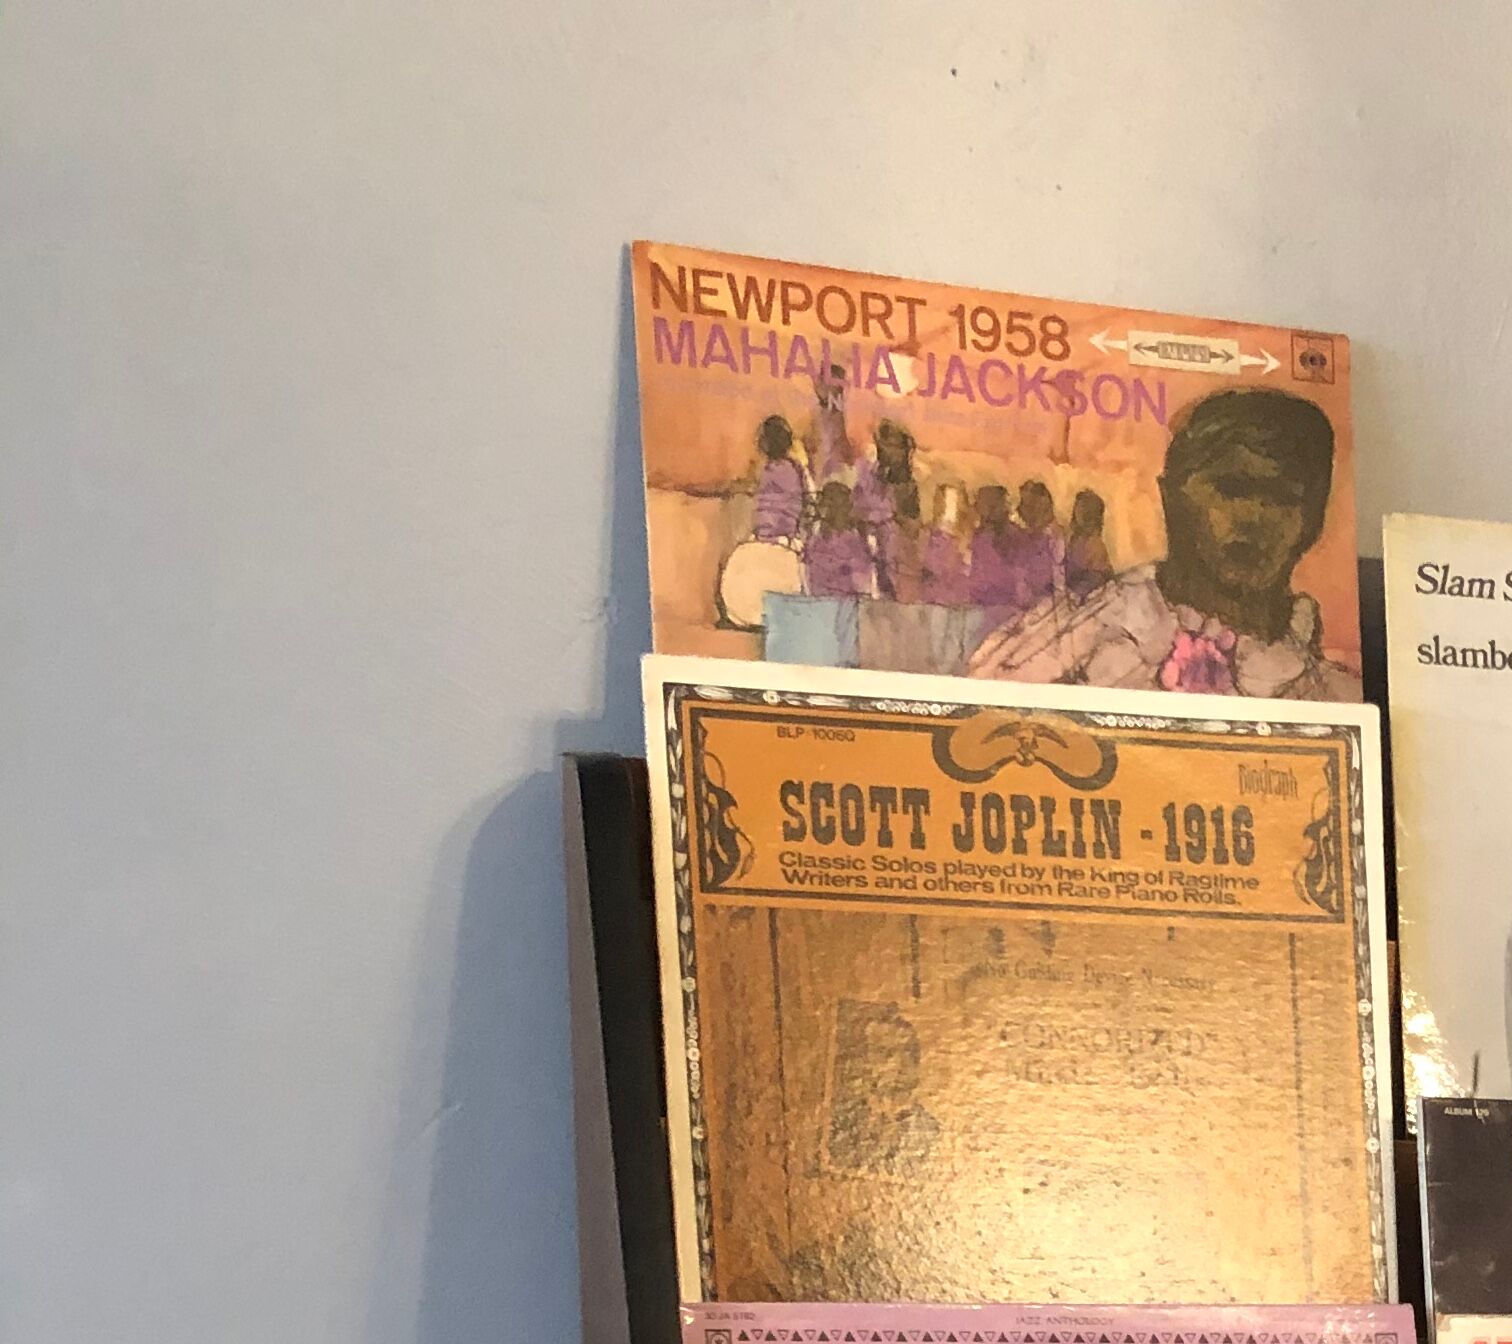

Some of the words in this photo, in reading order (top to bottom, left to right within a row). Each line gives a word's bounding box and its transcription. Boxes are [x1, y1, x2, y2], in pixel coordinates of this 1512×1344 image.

[650, 262, 927, 341] NEWPORT
[948, 303, 1071, 361] 1958
[653, 316, 901, 394] MAHALIA
[917, 352, 1168, 426] JACKSON
[1414, 561, 1496, 600] Slam
[780, 779, 930, 850] SCOTT
[953, 791, 1121, 860] JOPLIN
[779, 851, 866, 871] Classic
[871, 855, 937, 874] Solos
[944, 858, 1018, 882] played
[1021, 863, 1046, 881] by
[1052, 865, 1085, 881] the
[1090, 866, 1139, 887] King
[1144, 869, 1164, 885] of
[1169, 870, 1260, 892] Ragtime
[782, 868, 869, 888] Writers
[875, 874, 918, 891] and
[923, 876, 995, 895] others
[1000, 878, 1051, 897] from
[1057, 881, 1110, 899] Rare
[1115, 884, 1179, 903] Piano
